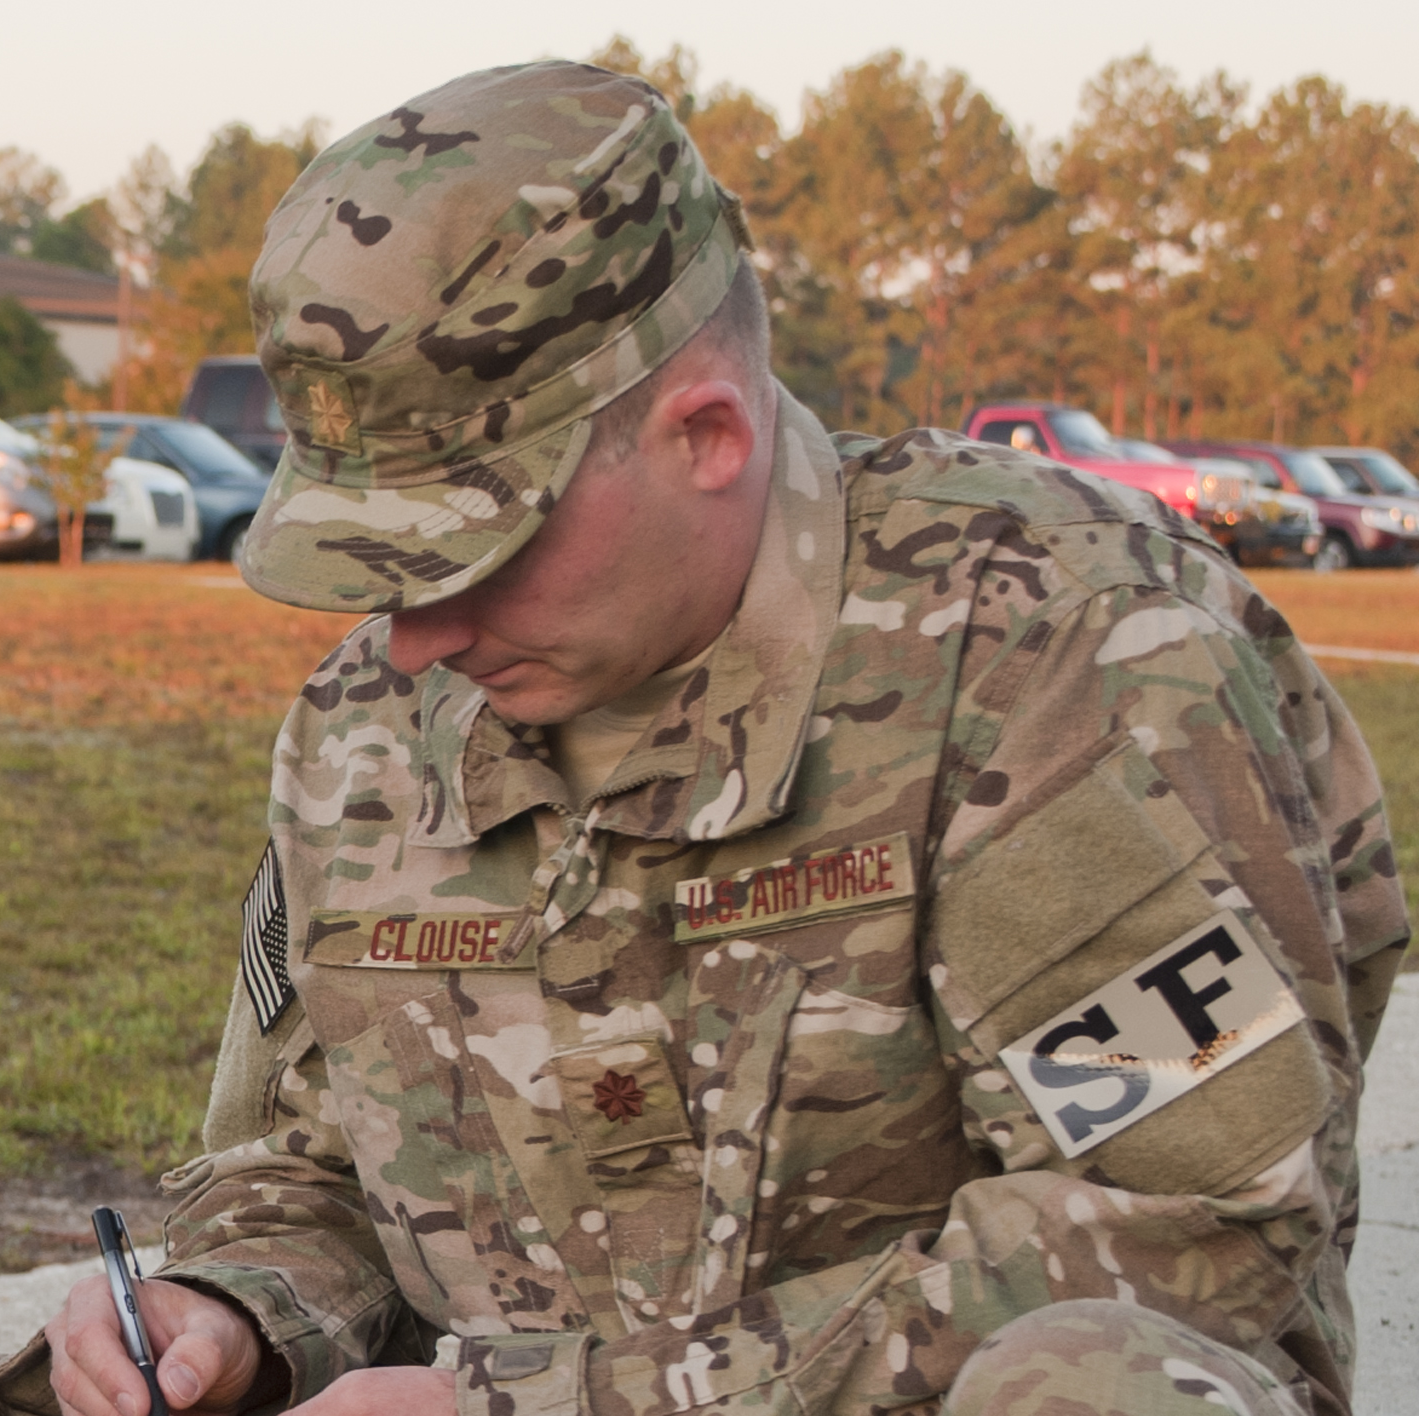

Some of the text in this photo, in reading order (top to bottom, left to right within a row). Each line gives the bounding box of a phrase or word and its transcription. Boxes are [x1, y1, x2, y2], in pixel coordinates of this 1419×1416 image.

[687, 844, 894, 930] U.S. AIR FORCE
[369, 919, 501, 963] CLOUSE
